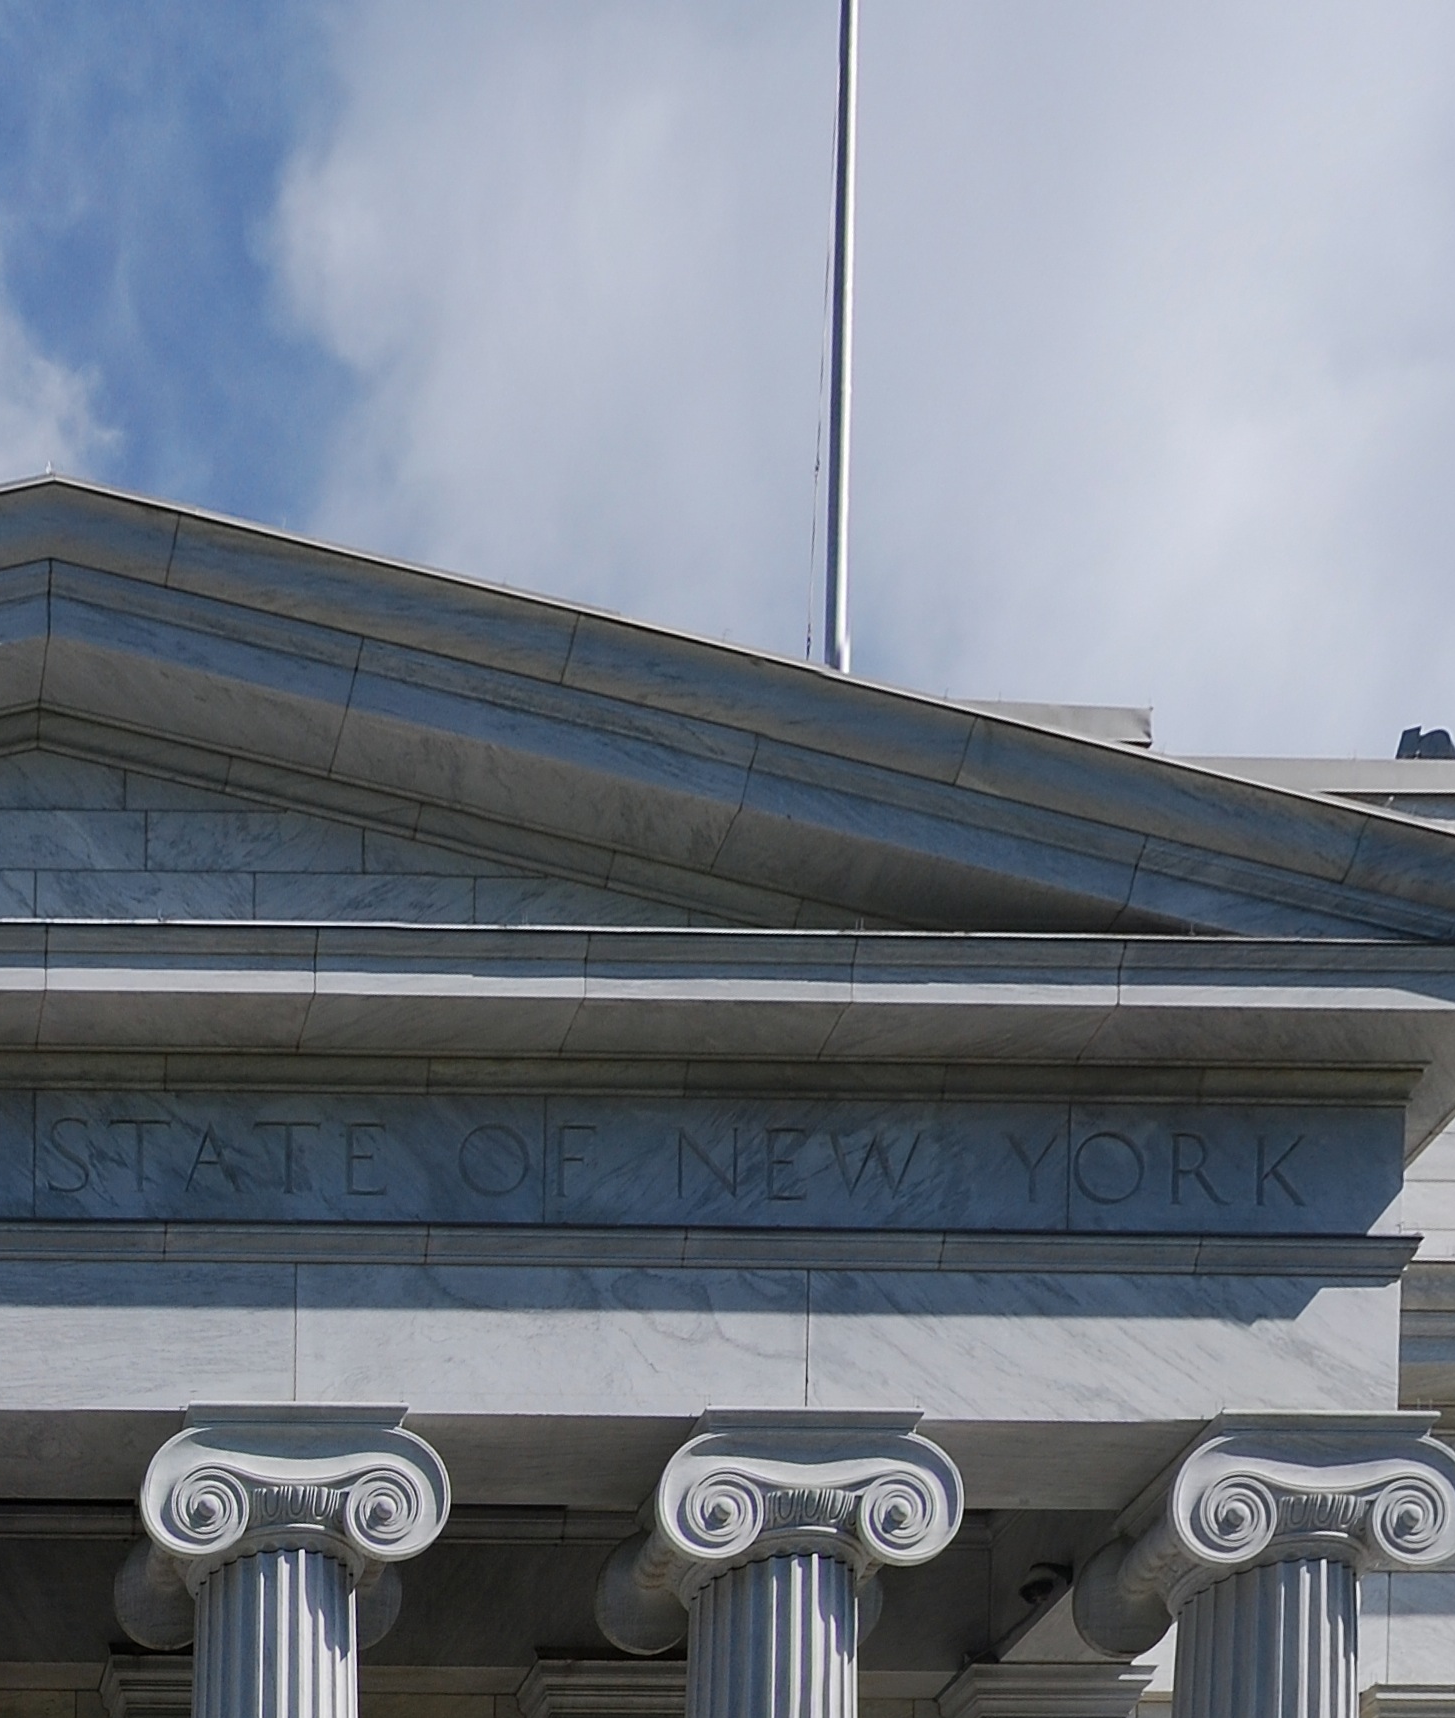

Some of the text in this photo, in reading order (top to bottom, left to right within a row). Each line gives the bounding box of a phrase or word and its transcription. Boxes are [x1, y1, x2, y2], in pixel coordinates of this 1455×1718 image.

[47, 1117, 388, 1196] STATE
[458, 1123, 597, 1198] OF
[676, 1126, 922, 1201] NEW
[1004, 1131, 1306, 1206] YORK
